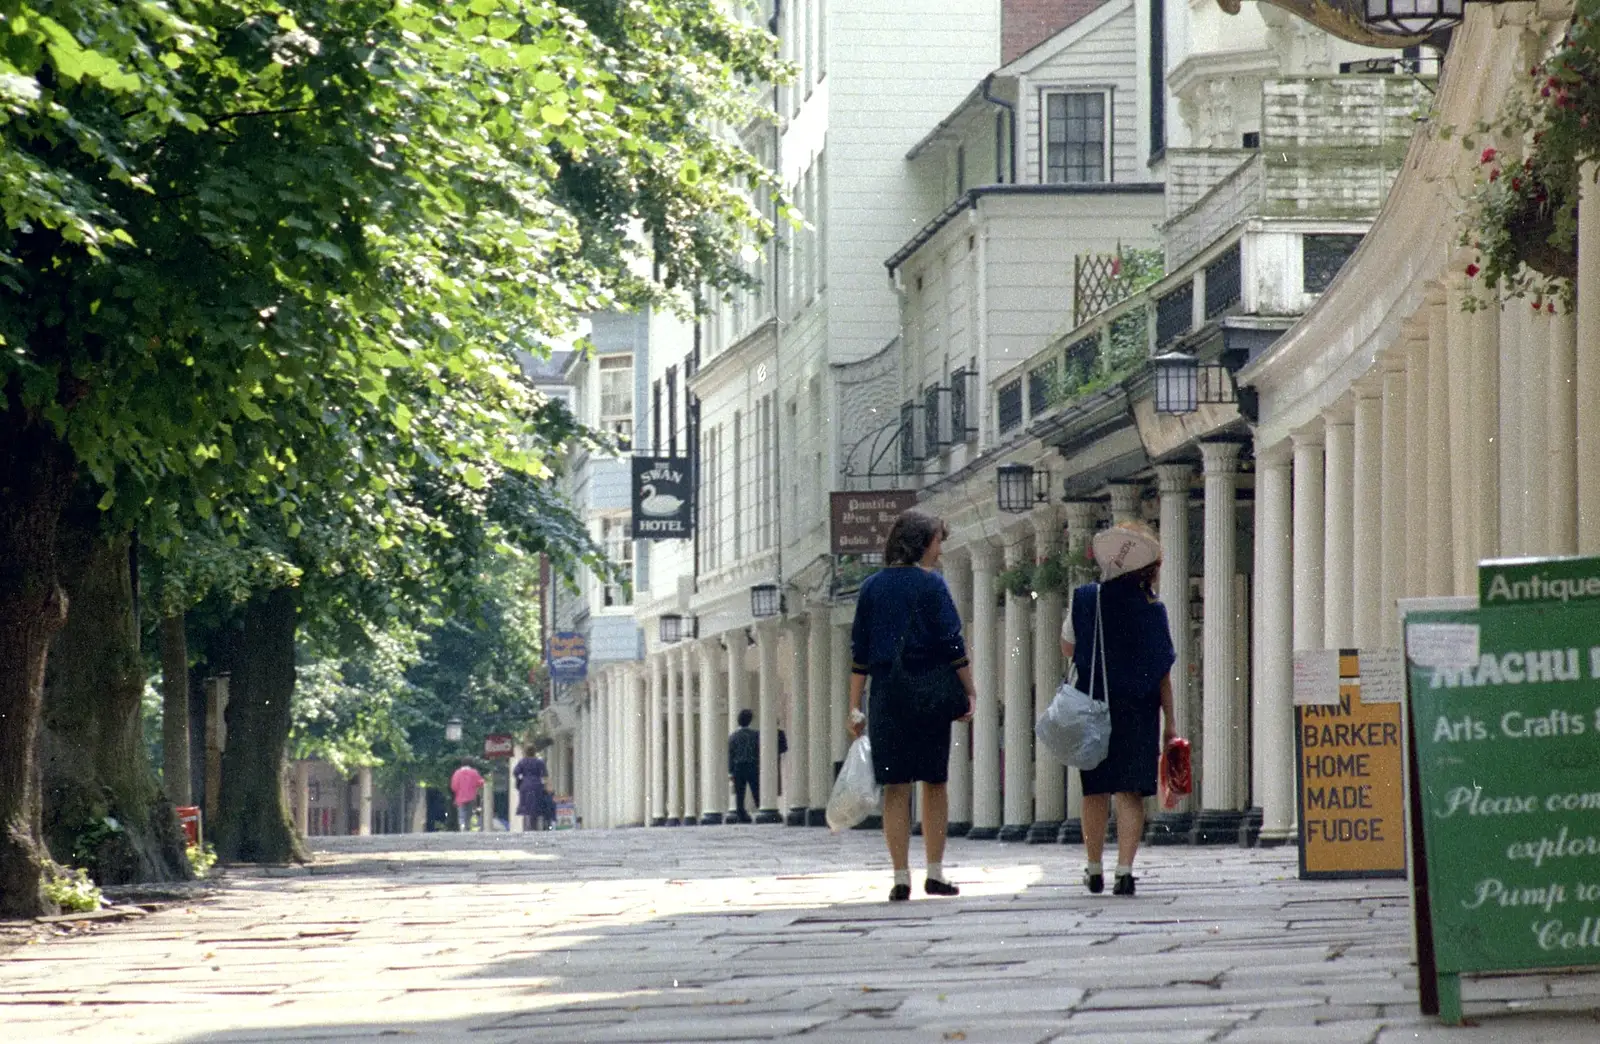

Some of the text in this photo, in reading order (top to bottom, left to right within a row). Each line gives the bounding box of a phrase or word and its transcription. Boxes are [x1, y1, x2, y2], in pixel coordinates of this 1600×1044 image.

[640, 469, 683, 484] SWAN
[848, 498, 897, 511] Pantiles
[639, 520, 685, 532] HOTEL
[1305, 694, 1351, 717] ANN
[1304, 722, 1398, 748] BARKER
[1501, 709, 1586, 738] Crafts
[1306, 753, 1370, 778] HOME
[1307, 785, 1373, 810] MADE
[1433, 786, 1538, 819] Please
[1307, 818, 1384, 842] FUDGE
[1461, 878, 1565, 913] Pump
